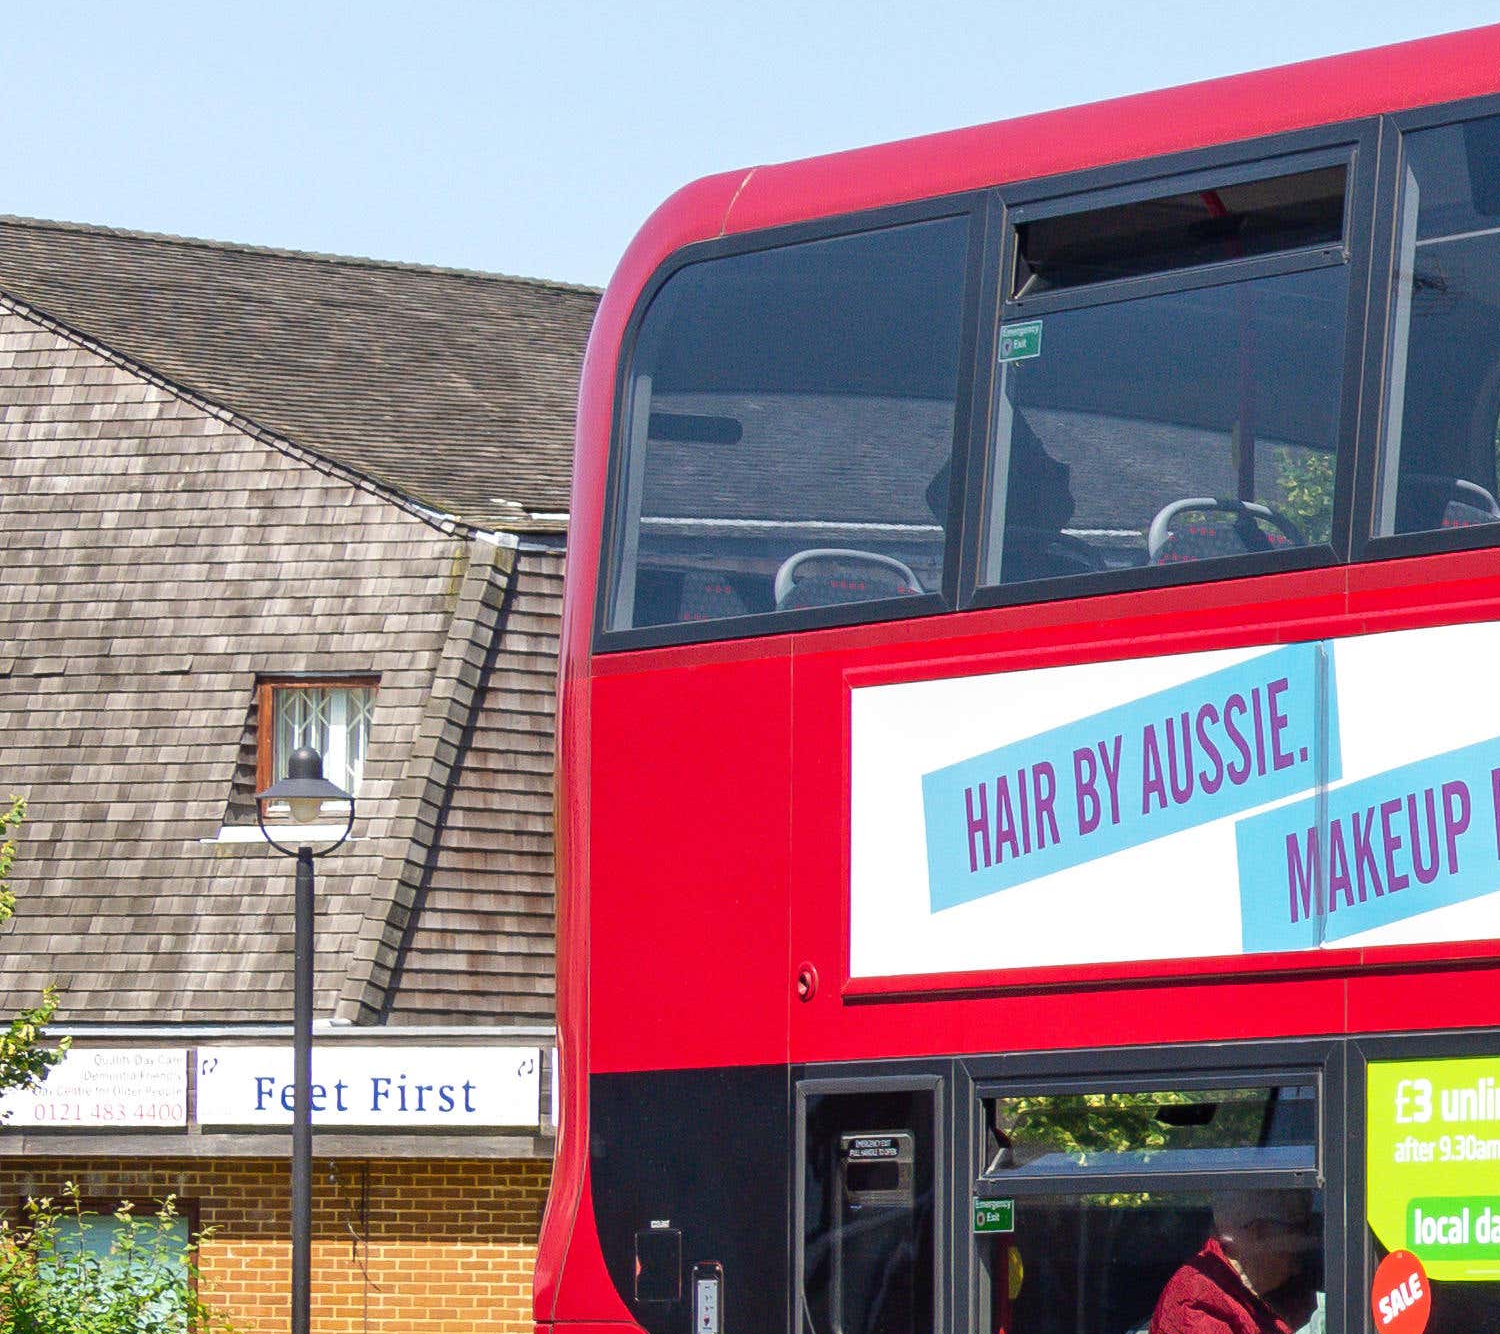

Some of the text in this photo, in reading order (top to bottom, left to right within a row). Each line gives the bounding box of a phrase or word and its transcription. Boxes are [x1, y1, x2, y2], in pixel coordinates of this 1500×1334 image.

[965, 678, 1308, 872] HAIR BY AUSSIE.
[1286, 781, 1471, 924] MAKEUP
[34, 1103, 184, 1122] 0121 483 4400
[253, 1073, 477, 1113] Feet First
[1394, 1077, 1434, 1124] £3
[1393, 1135, 1436, 1164] after
[975, 1199, 1011, 1210] Emergency
[1414, 1207, 1470, 1245] local
[1378, 1272, 1424, 1325] SALE
